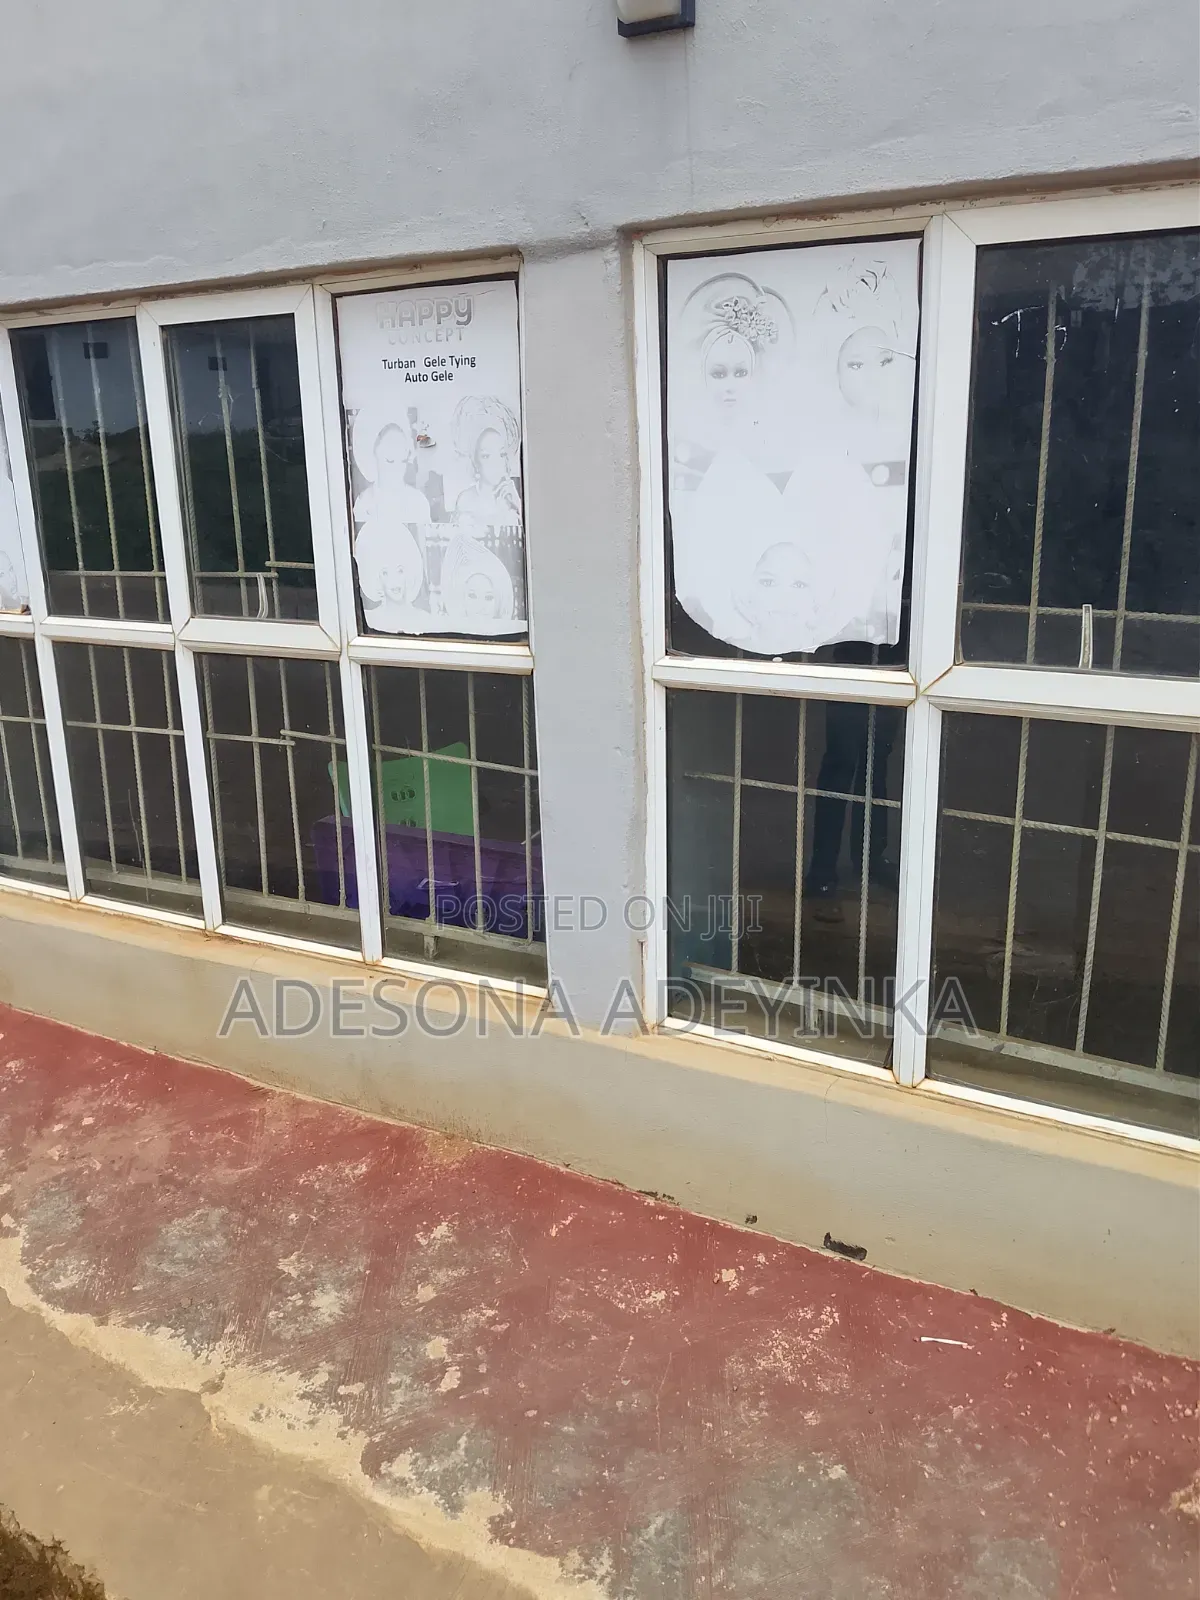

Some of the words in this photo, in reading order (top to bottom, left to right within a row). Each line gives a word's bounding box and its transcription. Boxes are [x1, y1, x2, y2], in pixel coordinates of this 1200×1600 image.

[381, 358, 416, 370] Turban
[423, 355, 447, 368] Gele
[448, 354, 477, 368] Tying
[404, 372, 429, 383] Auto
[431, 370, 454, 382] Gele
